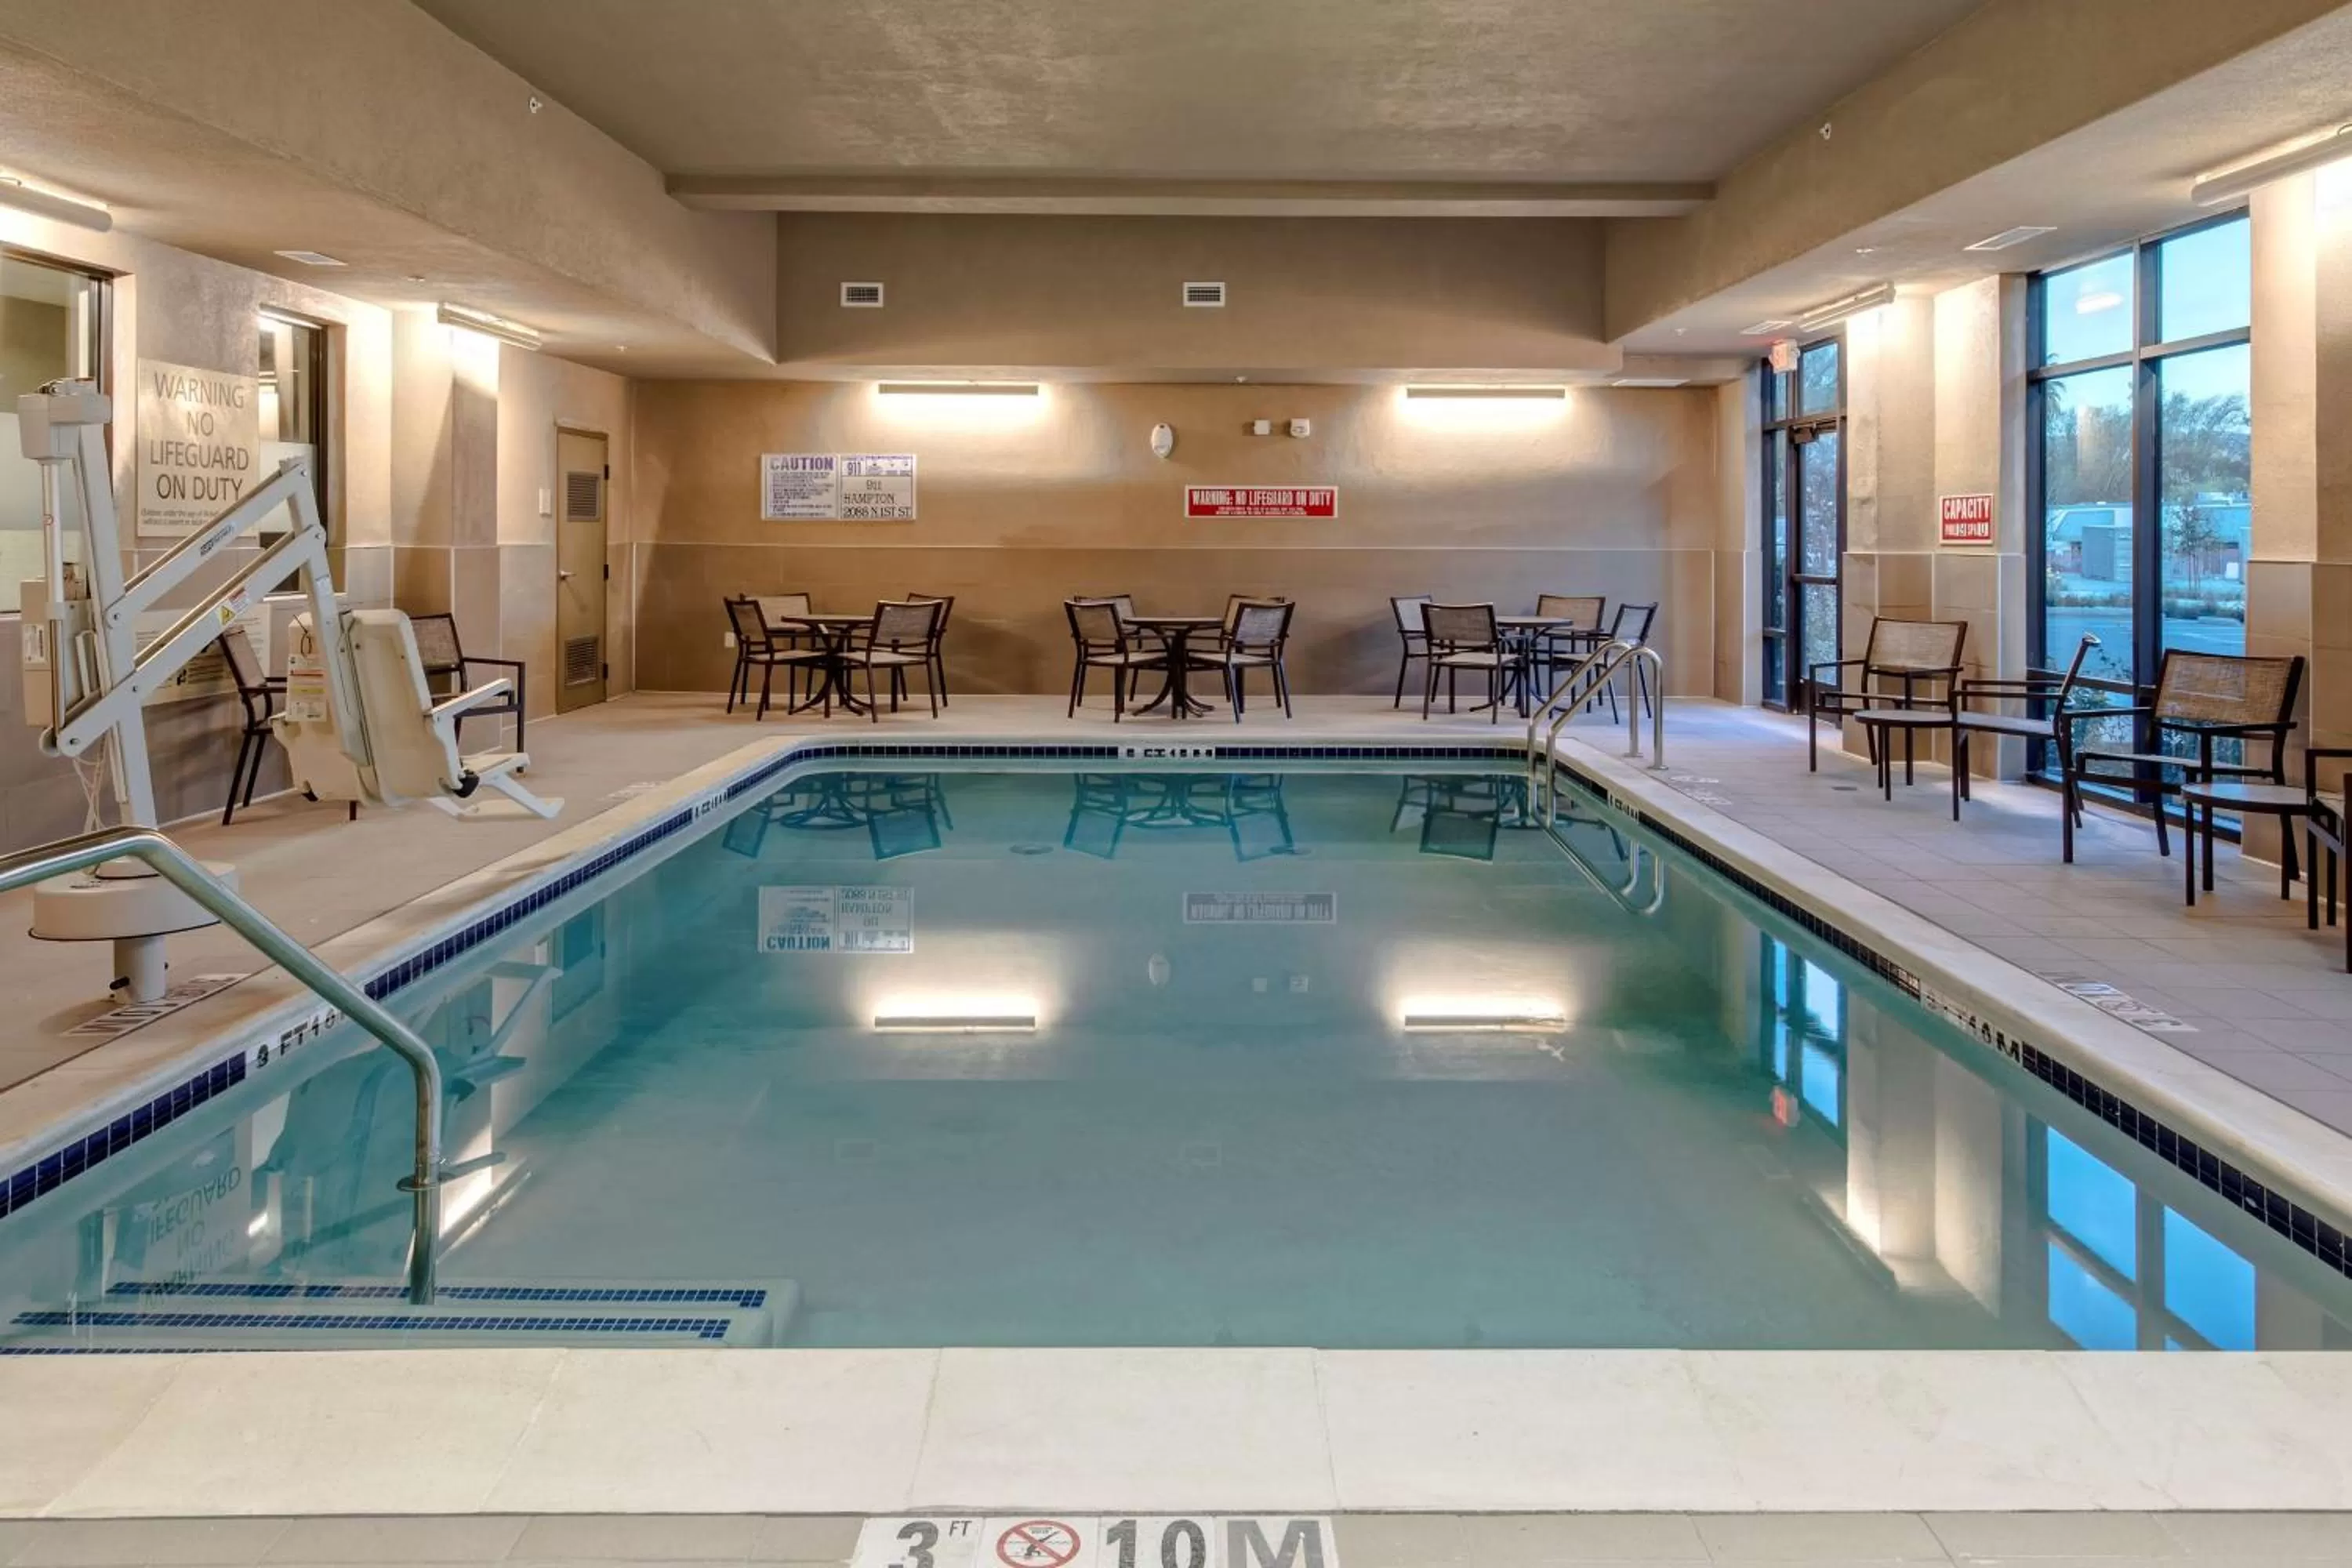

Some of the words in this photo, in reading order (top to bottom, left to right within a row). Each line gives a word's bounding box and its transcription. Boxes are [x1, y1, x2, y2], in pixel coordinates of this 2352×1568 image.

[154, 370, 245, 409] WARNING
[187, 411, 214, 437] NO
[150, 439, 249, 470] LIFEGUARD
[771, 457, 833, 470] CAUTION
[157, 474, 186, 500] ON
[193, 476, 243, 501] DUTY
[844, 493, 895, 504] HAMPTON
[1236, 491, 1247, 506] NO
[1249, 491, 1293, 506] LIFEGUARD
[1295, 491, 1306, 506] ON
[1308, 491, 1330, 506] DUTY
[1944, 498, 1989, 520] CAPACITY
[887, 1520, 939, 1568] 3
[949, 1520, 972, 1537] FT
[1107, 1519, 1206, 1568] 10
[1227, 1520, 1325, 1568] M
